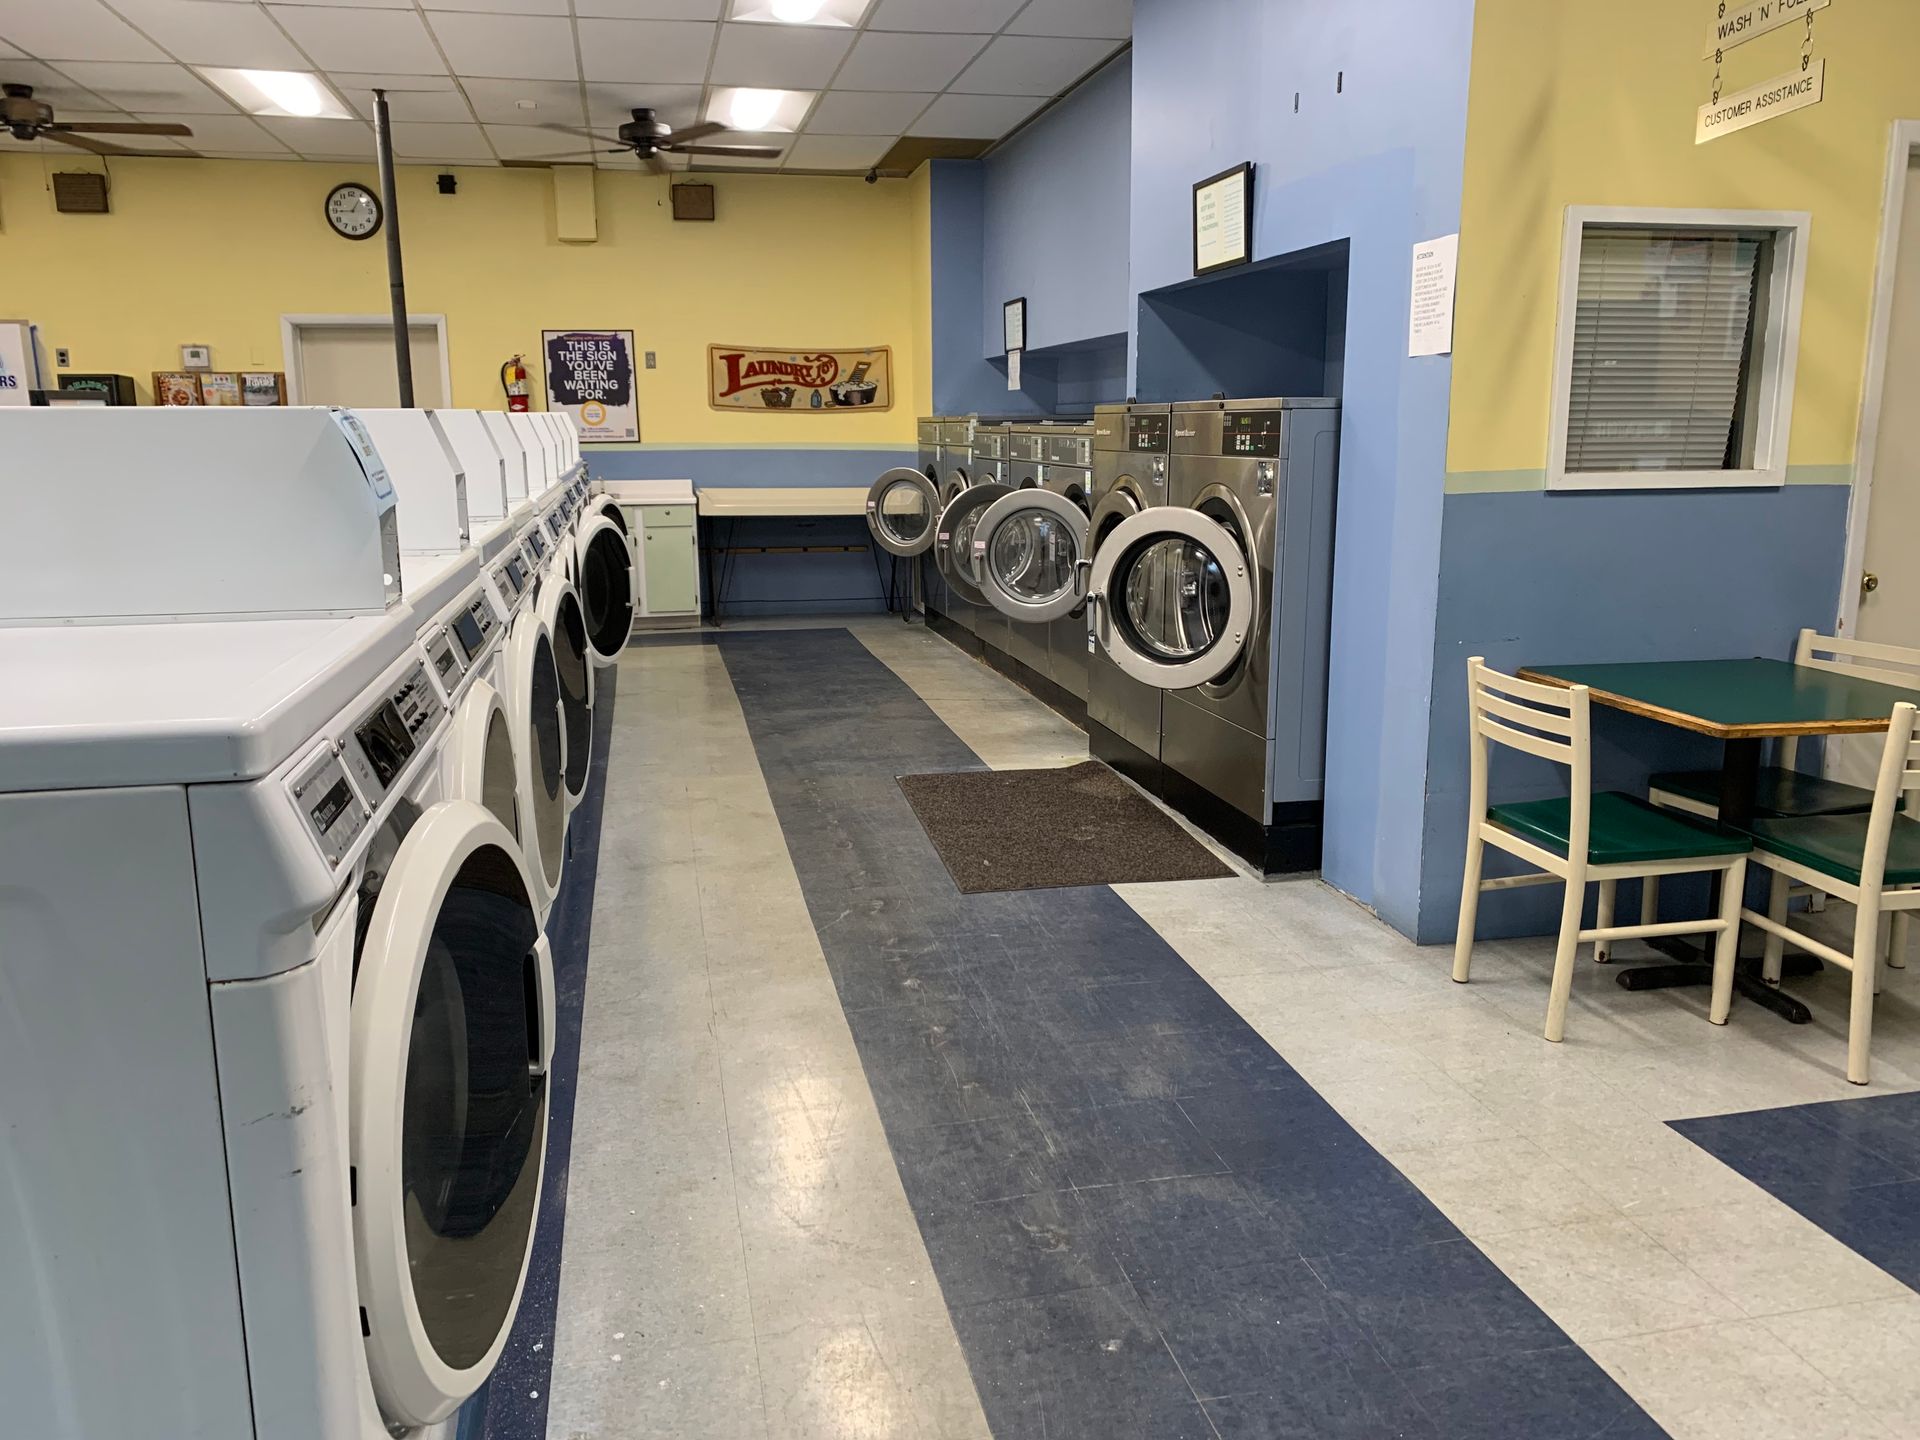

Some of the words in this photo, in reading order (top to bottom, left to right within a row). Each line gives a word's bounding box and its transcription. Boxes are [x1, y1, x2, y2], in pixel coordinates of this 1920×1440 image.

[1718, 12, 1751, 40] WASH
[1758, 2, 1773, 21] 'N'
[1778, 0, 1807, 13] FOL
[1704, 100, 1751, 127] CUSTOMER
[1755, 77, 1813, 110] ASSISTANCE
[566, 341, 596, 351] THIS
[599, 341, 611, 351] IS
[558, 351, 583, 361] THE
[586, 351, 617, 361] SIGN
[566, 360, 614, 371] YOU'VE
[574, 370, 608, 380] BEEN
[718, 353, 815, 397] LAUNDRY
[563, 380, 619, 390] WAITING
[577, 389, 607, 400] FOR.
